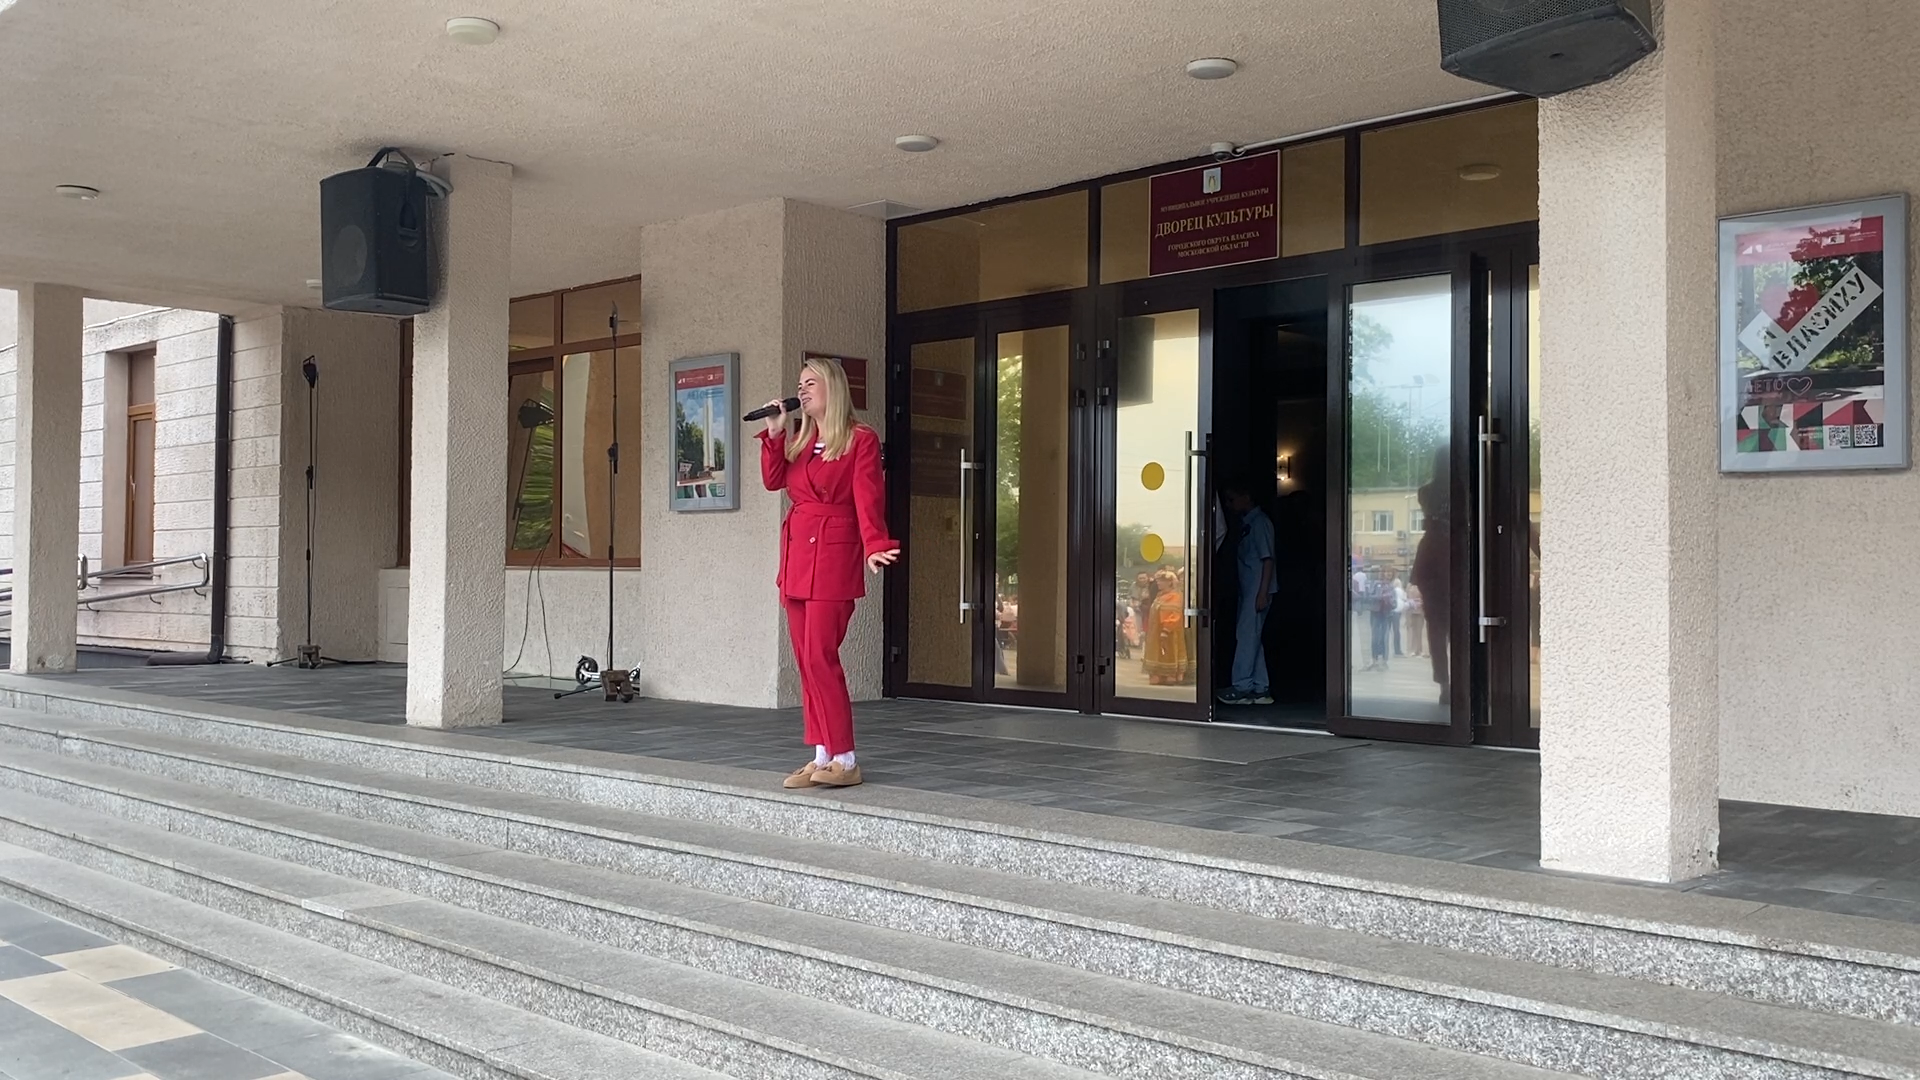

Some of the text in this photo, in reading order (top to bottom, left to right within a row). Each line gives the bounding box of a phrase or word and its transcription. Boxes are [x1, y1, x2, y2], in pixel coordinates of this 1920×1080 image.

[1241, 187, 1269, 198] КУЛЬТУРЫ
[1154, 203, 1274, 238] ДВОРЕЦ КУЛЬТУРЫ
[1168, 231, 1260, 251] ГОРОДСКОГО ОКРУГА ВЛАСИХА
[1177, 241, 1249, 258] МОСКОВСКОЙ ОБЛАСТИ
[1772, 272, 1866, 370] ВЛАСИХУ
[1744, 378, 1784, 393] ЛЕТО
